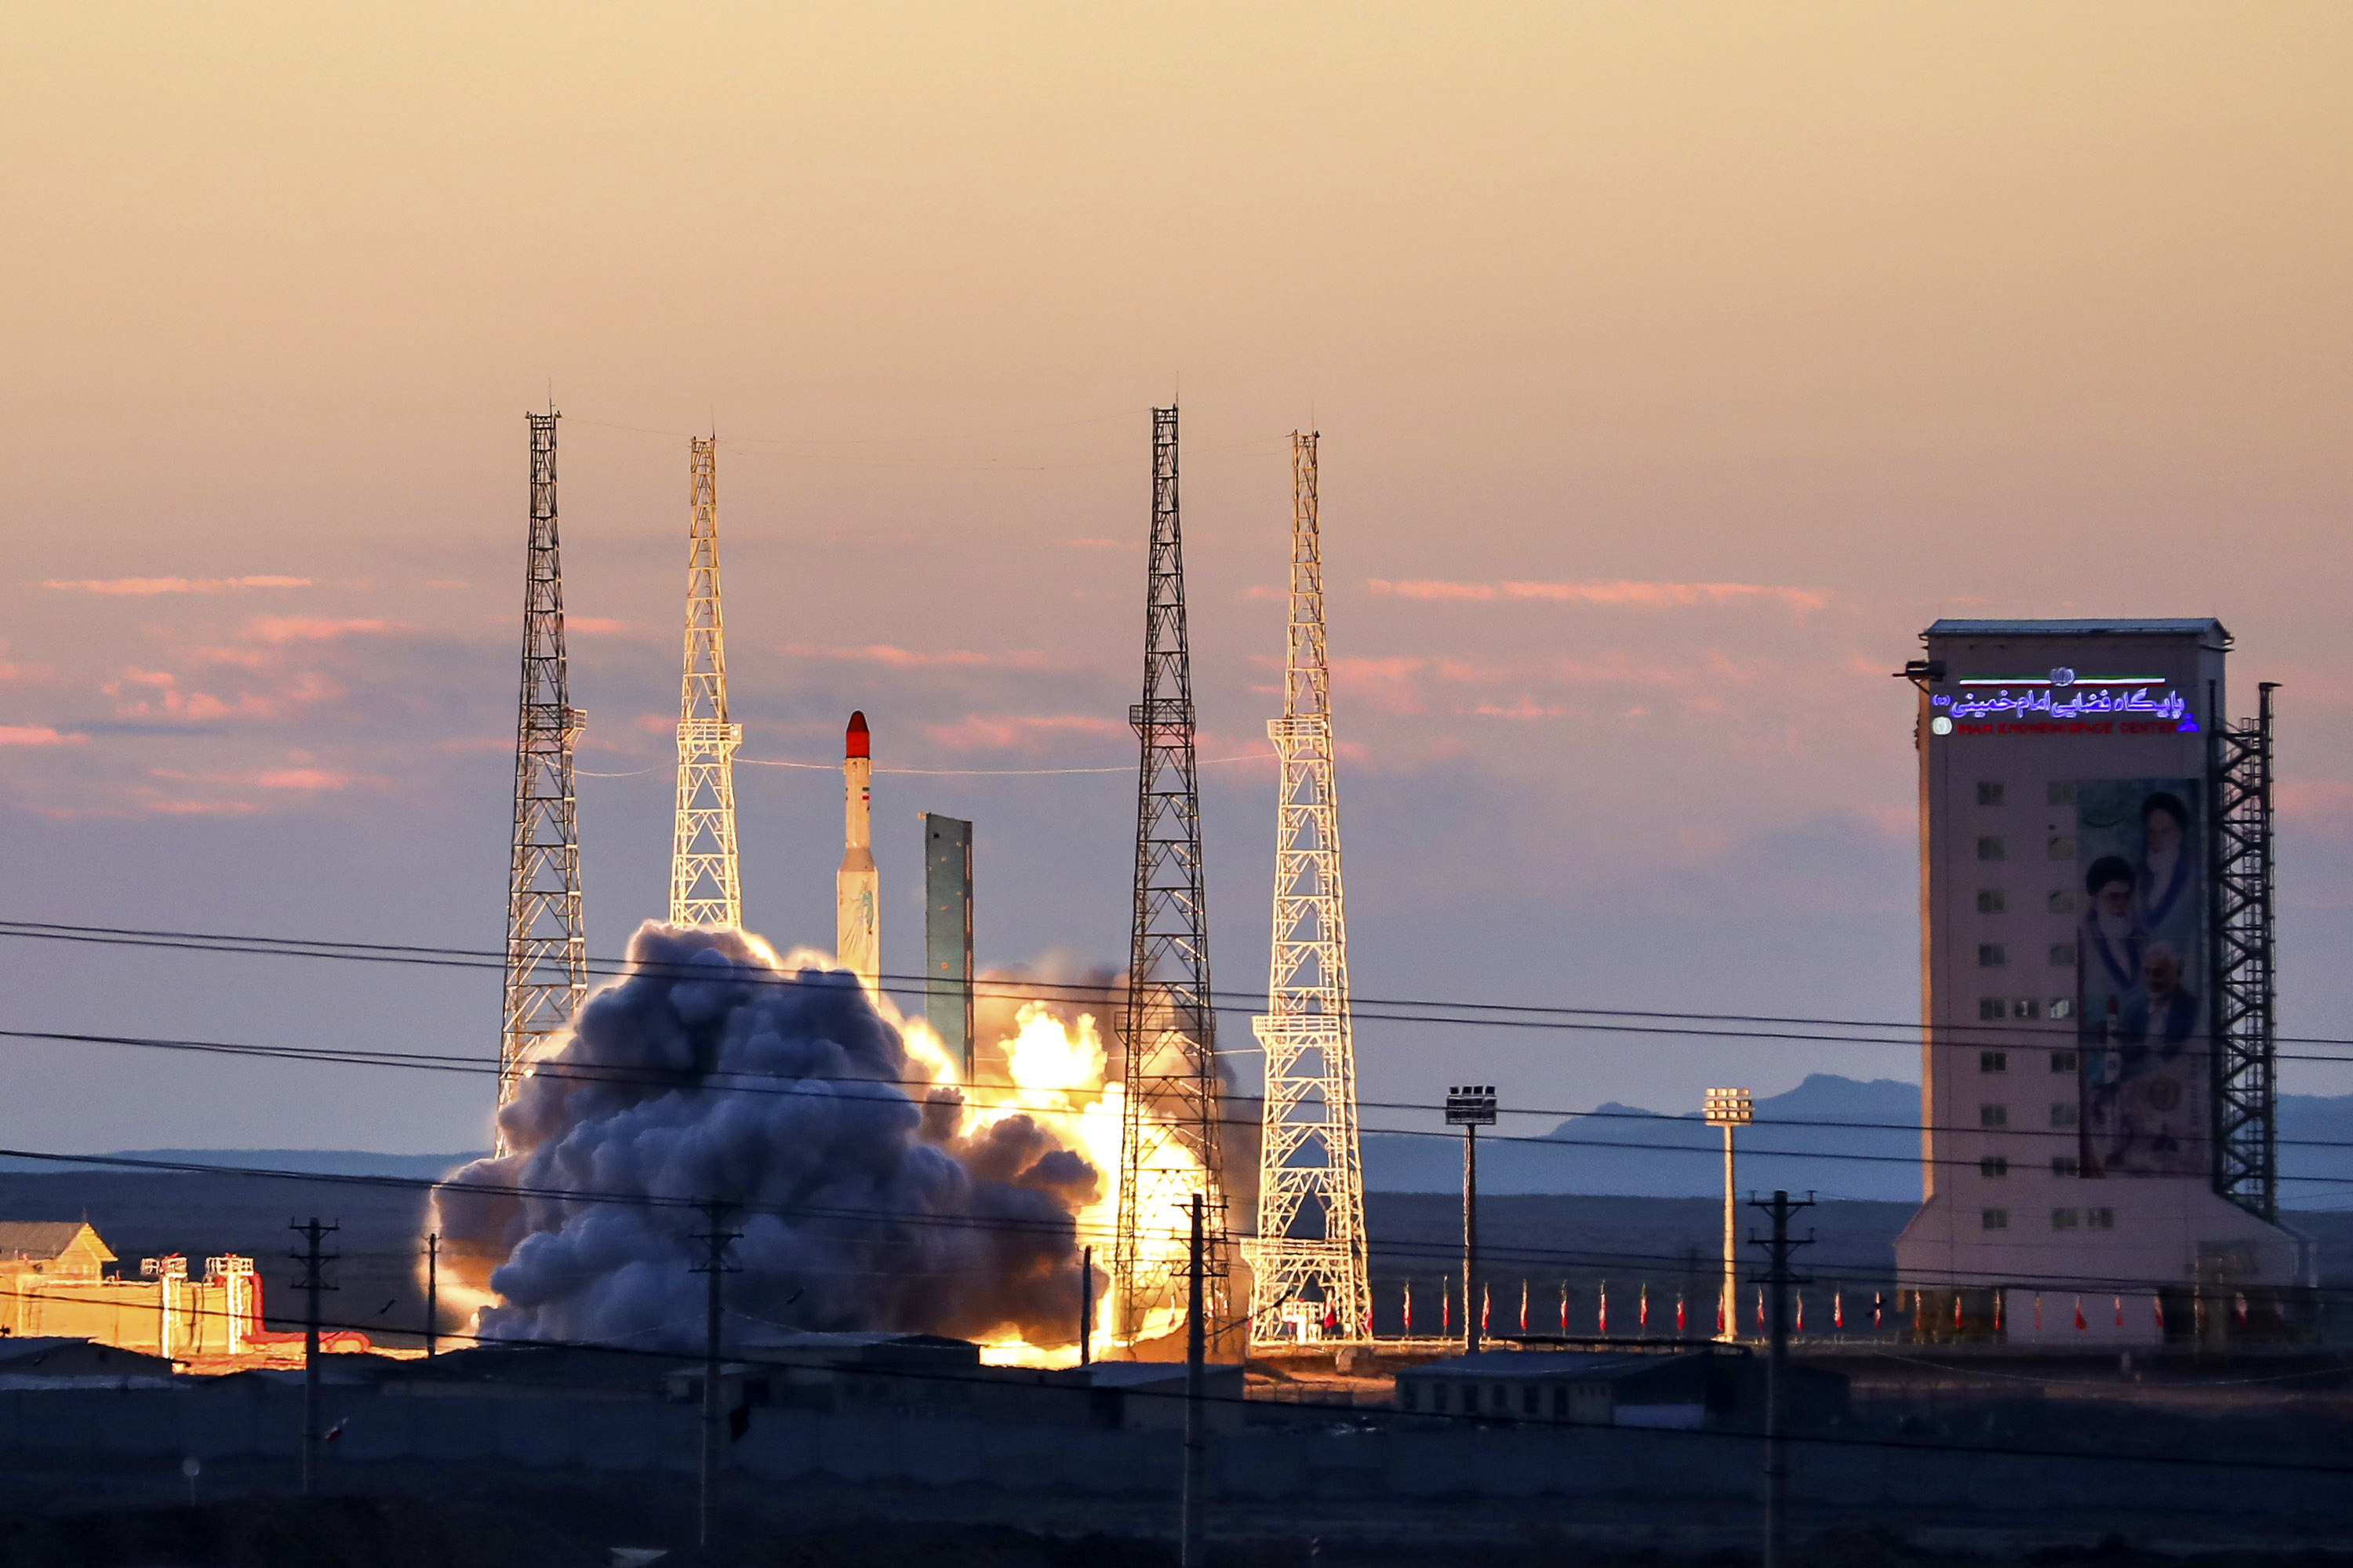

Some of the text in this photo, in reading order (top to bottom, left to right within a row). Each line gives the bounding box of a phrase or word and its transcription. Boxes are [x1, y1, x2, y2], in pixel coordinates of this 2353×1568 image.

[1951, 689, 2017, 718] خمینی
[2017, 689, 2051, 719] امام
[2050, 689, 2111, 718] فضایی
[2115, 687, 2184, 719] پایگاه
[1957, 722, 1992, 734] IMAM
[2068, 722, 2112, 733] SPACE
